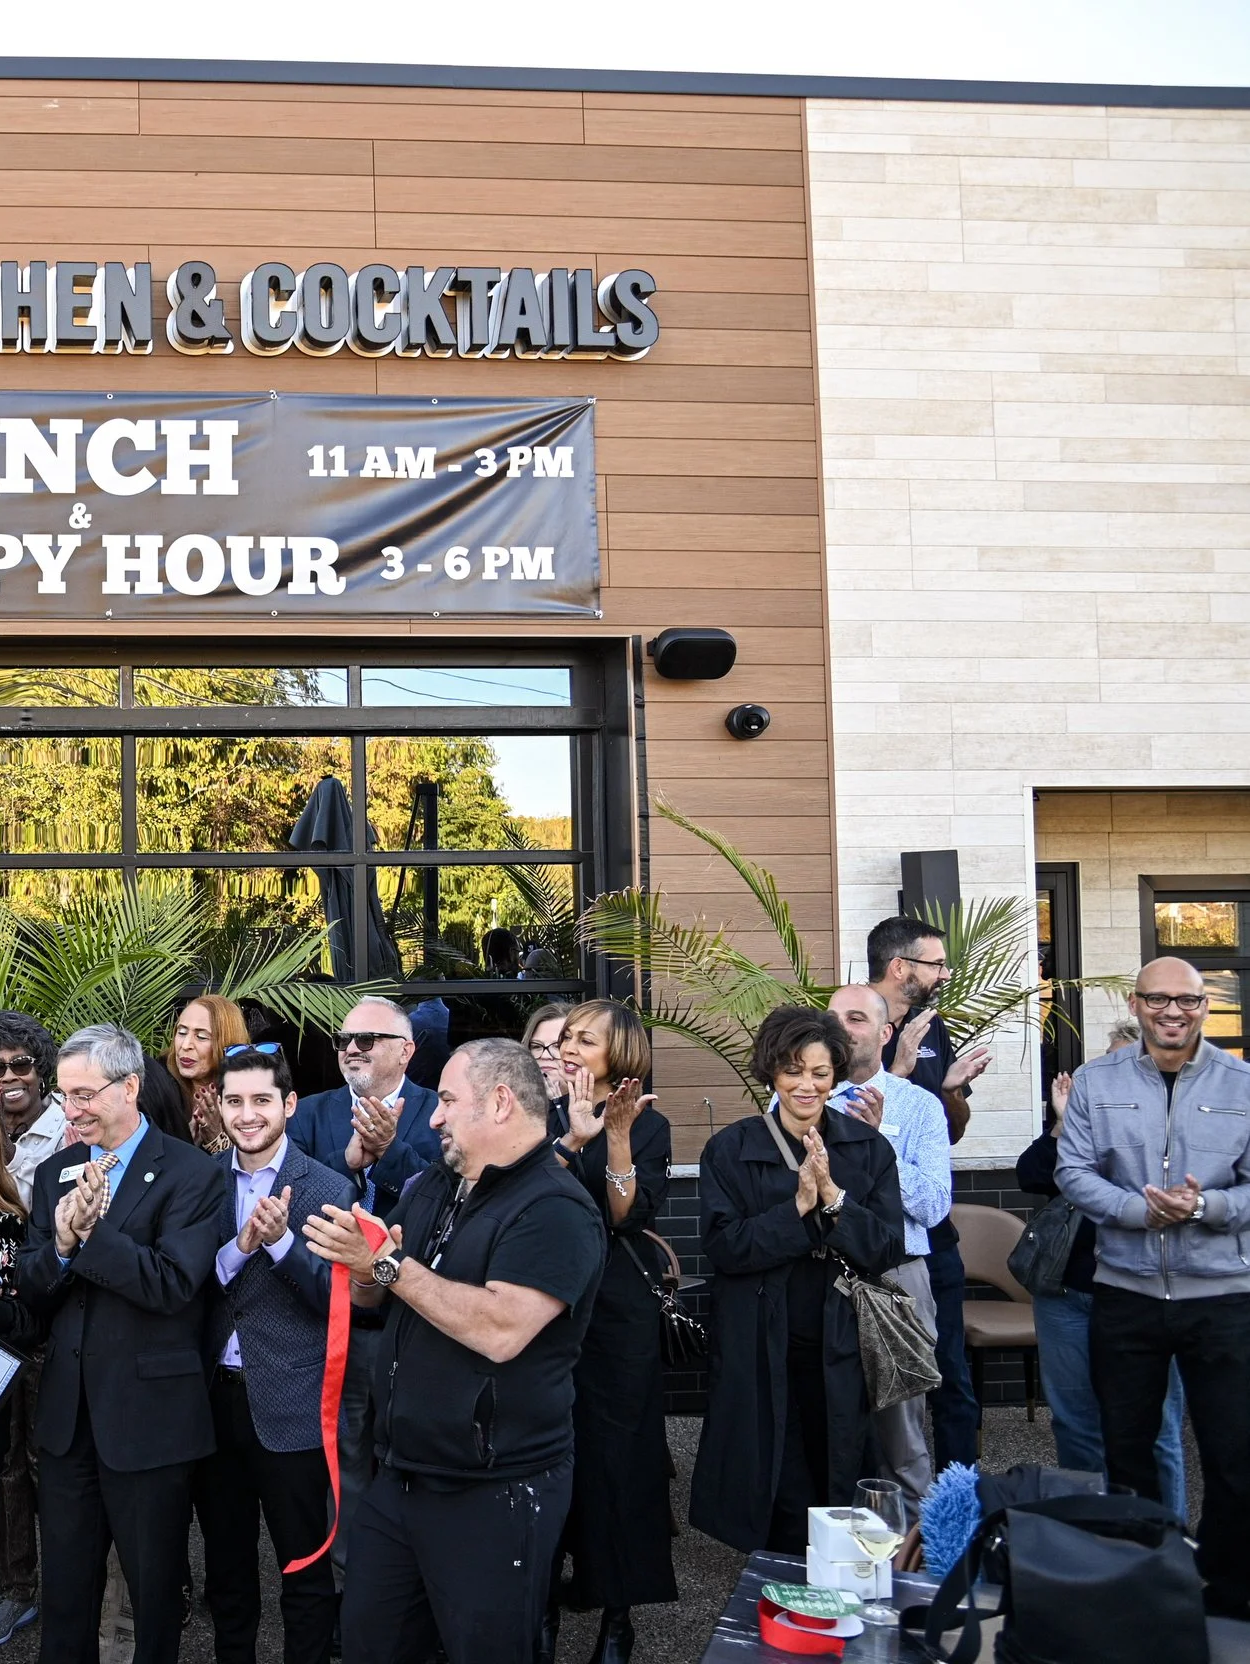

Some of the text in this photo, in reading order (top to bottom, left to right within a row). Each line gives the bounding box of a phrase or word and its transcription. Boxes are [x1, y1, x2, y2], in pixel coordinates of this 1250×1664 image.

[168, 260, 233, 353] &
[242, 262, 659, 360] COCKTAILS
[307, 445, 574, 478] 11 AM - 3 PM
[69, 503, 91, 528] &
[102, 534, 346, 595] HOUR
[381, 546, 555, 580] 3 - 6 PM
